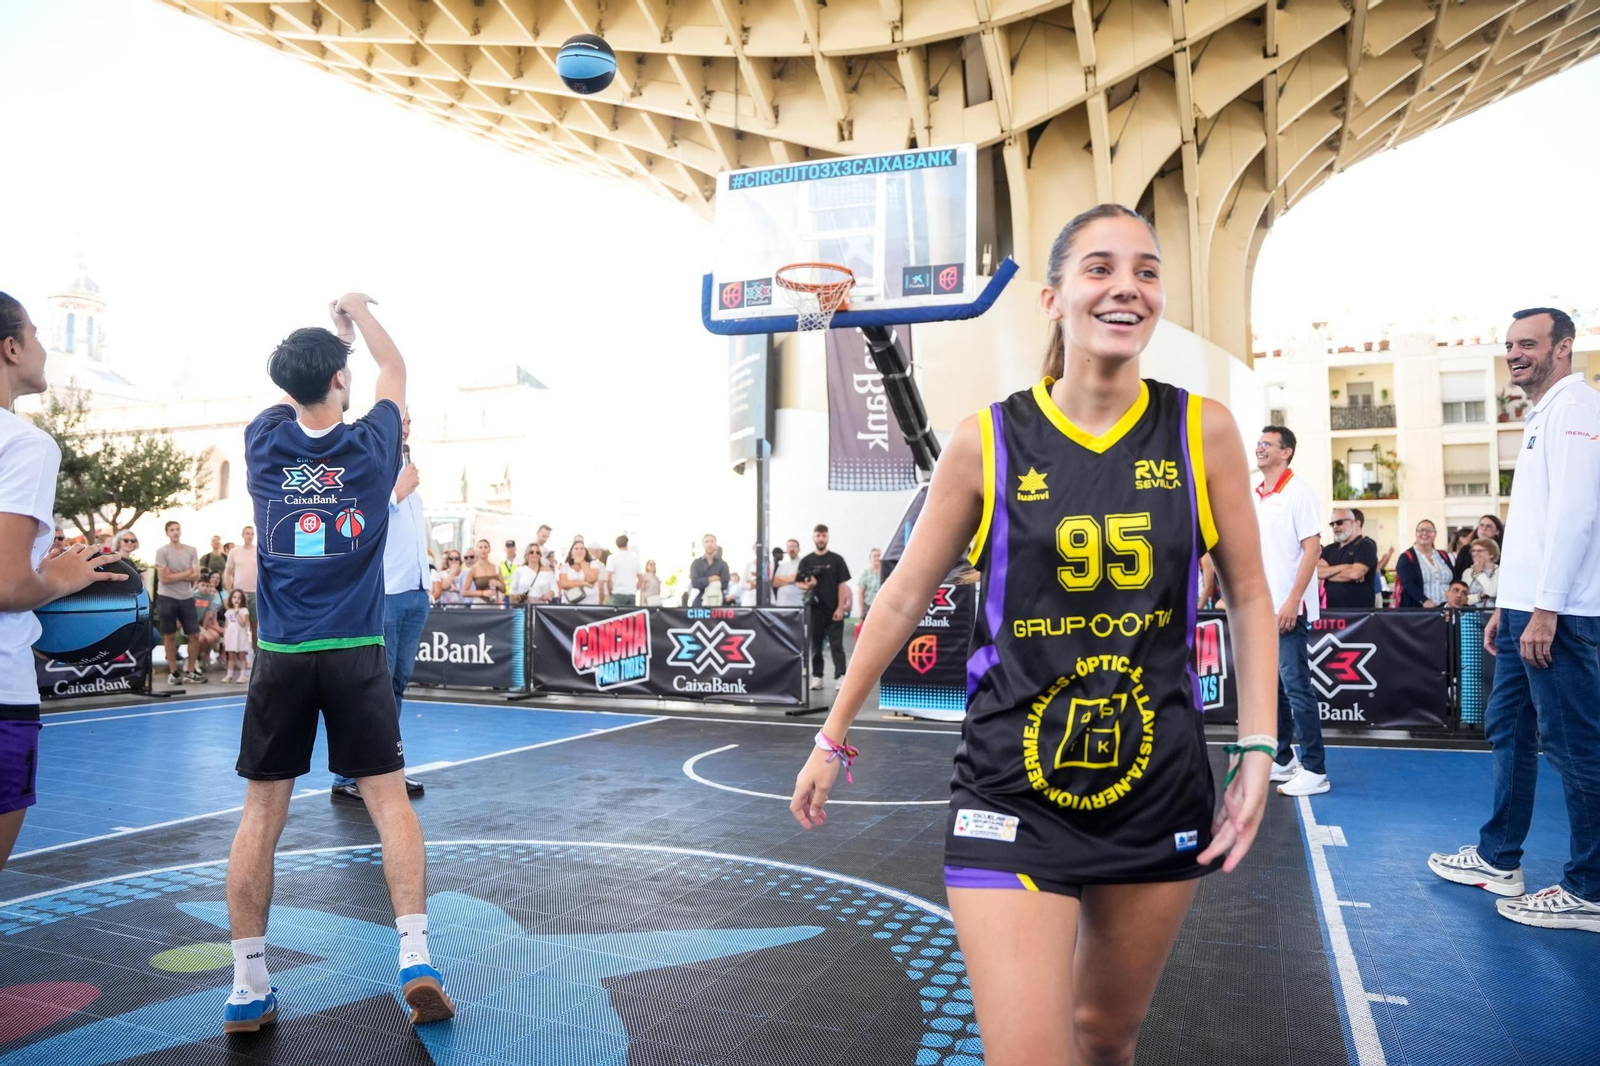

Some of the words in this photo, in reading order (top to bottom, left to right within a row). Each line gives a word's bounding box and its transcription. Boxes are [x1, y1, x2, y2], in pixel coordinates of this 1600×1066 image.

[732, 150, 953, 189] #CIRCUITO3X3CAIXABANK
[1135, 478, 1182, 490] SEVILLA
[284, 494, 338, 505] CaixaBank
[1017, 491, 1049, 502] luanvi
[1056, 512, 1153, 592] 95
[687, 608, 734, 619] CIRCUITO
[414, 631, 495, 664] aBank
[575, 612, 646, 669] CANCHA
[598, 661, 619, 685] PARA
[53, 676, 132, 695] CaixaBank
[673, 675, 748, 694] CaixaBank
